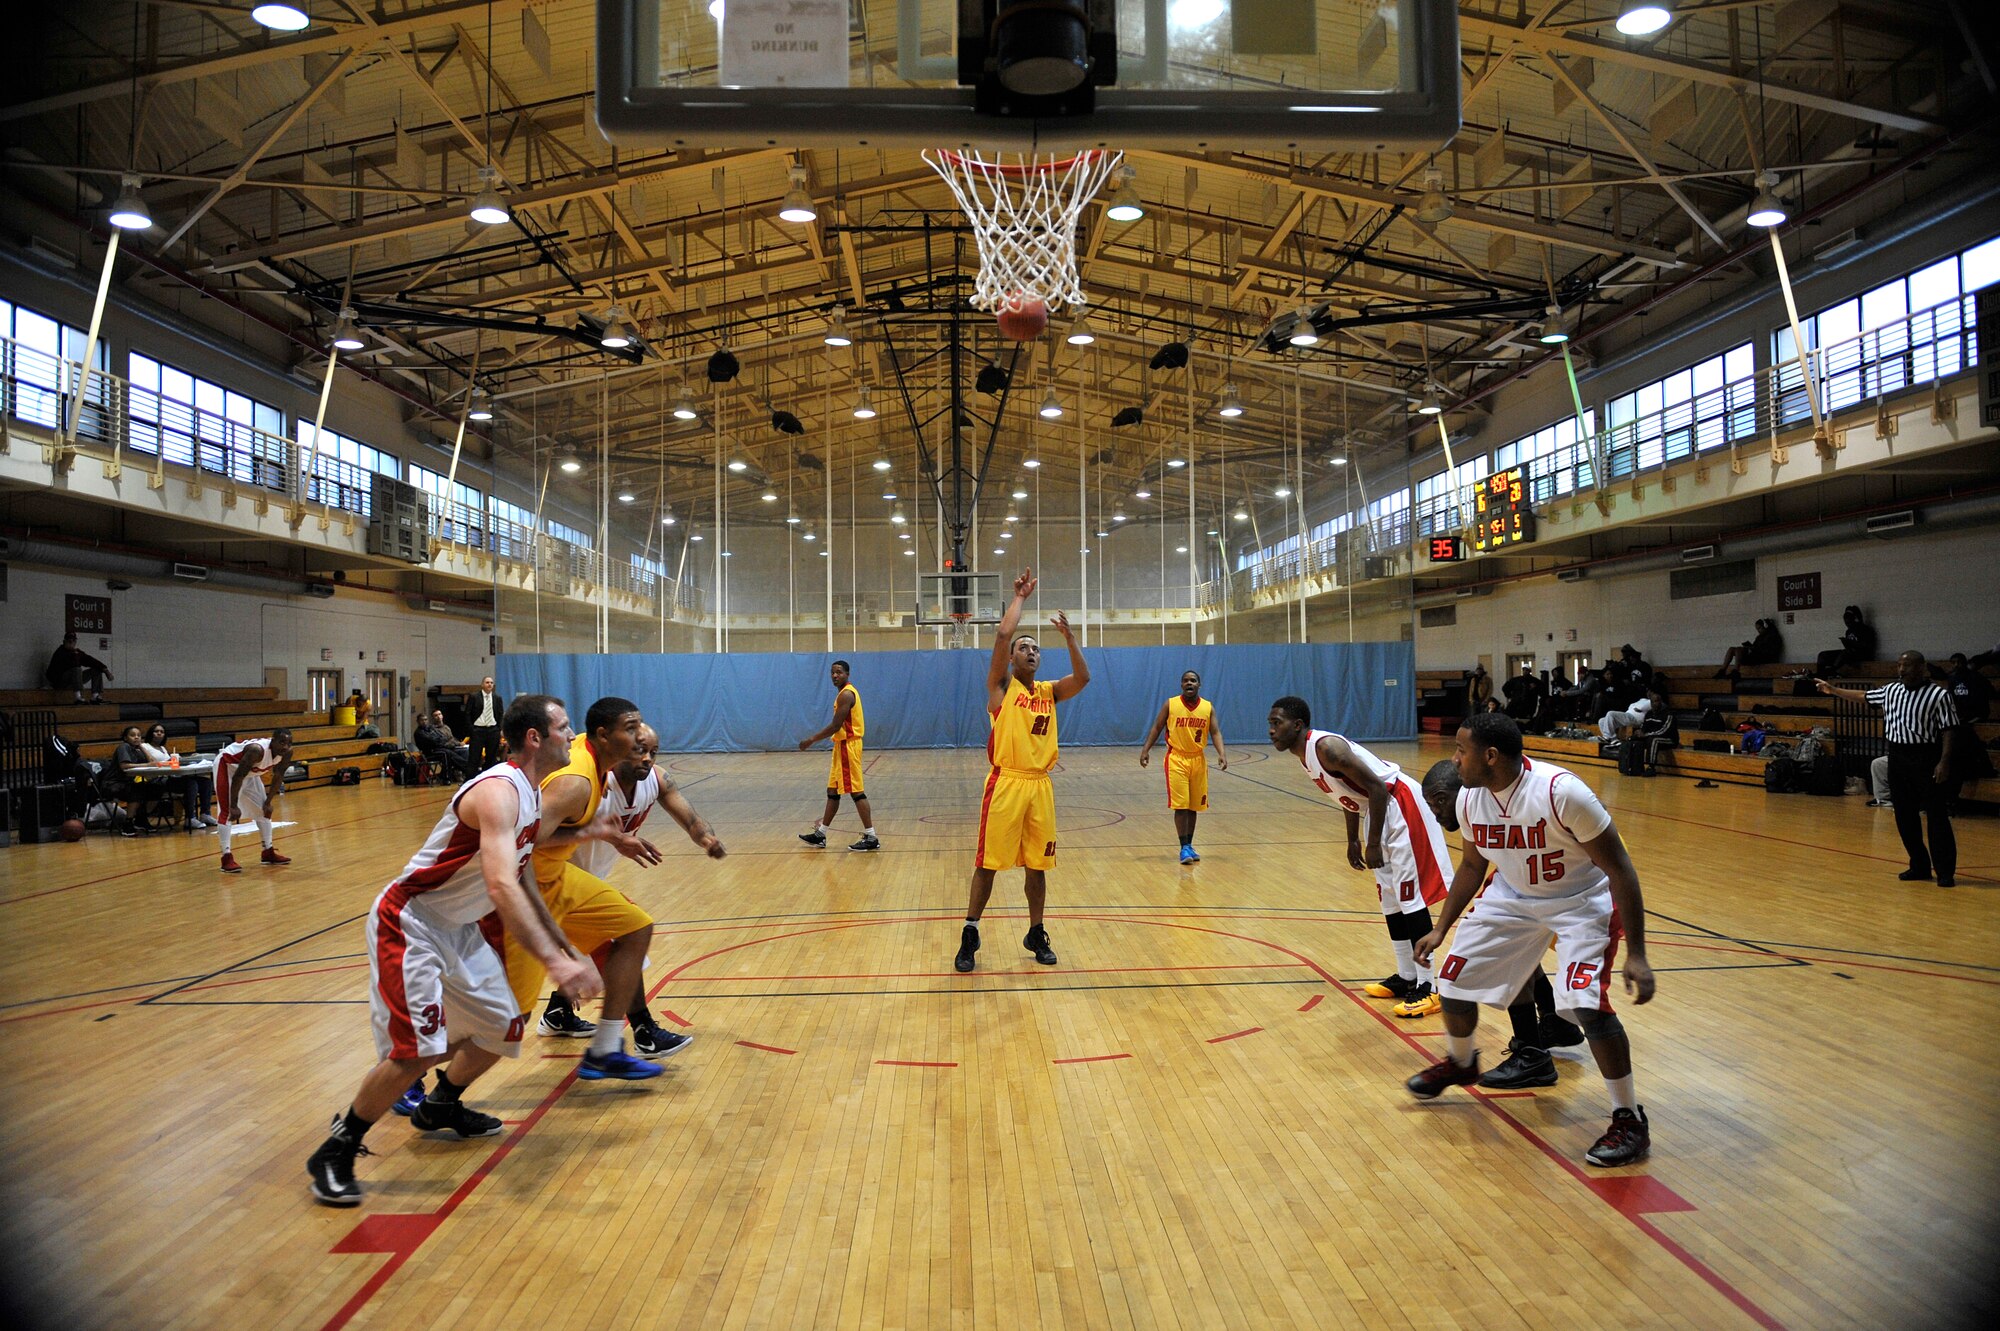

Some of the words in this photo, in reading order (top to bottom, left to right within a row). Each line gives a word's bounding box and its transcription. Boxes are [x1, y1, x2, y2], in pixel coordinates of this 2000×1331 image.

[1432, 539, 1453, 558] 35
[1784, 579, 1807, 591] Court
[1809, 577, 1814, 588] 1
[73, 600, 97, 612] Court
[1785, 596, 1804, 607] Side
[1807, 594, 1814, 605] B
[74, 617, 94, 629] Side
[97, 619, 104, 629] B
[1014, 692, 1052, 714] PARITS
[1031, 714, 1051, 736] 21
[1175, 716, 1207, 728] PATRIOTS
[1194, 729, 1203, 743] 2
[1472, 817, 1548, 850] OSAN
[1526, 849, 1565, 885] 15
[1566, 961, 1598, 992] 15
